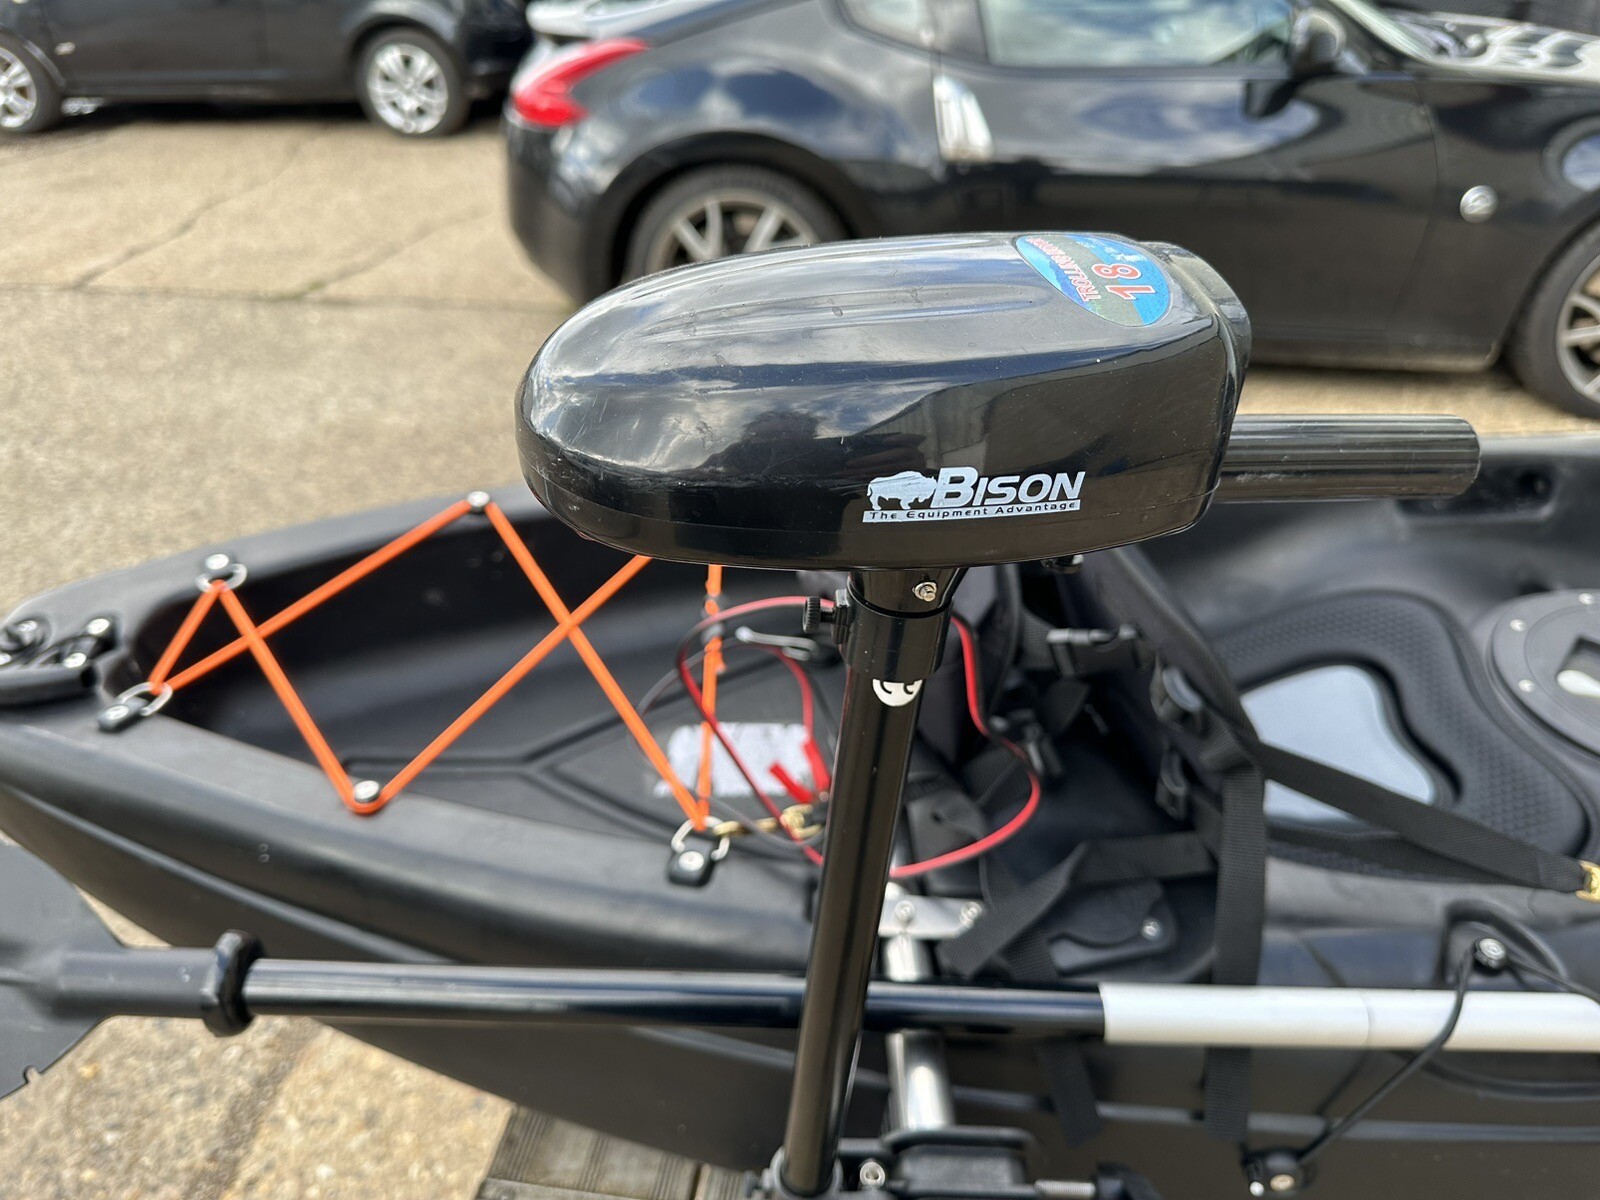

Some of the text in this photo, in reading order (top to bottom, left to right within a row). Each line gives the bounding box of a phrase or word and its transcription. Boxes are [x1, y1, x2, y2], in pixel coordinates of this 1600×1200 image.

[1051, 254, 1101, 302] TROLLING
[1091, 263, 1157, 300] 18
[930, 466, 1086, 509] BISON
[869, 502, 1075, 520] The Equipment Advantage
